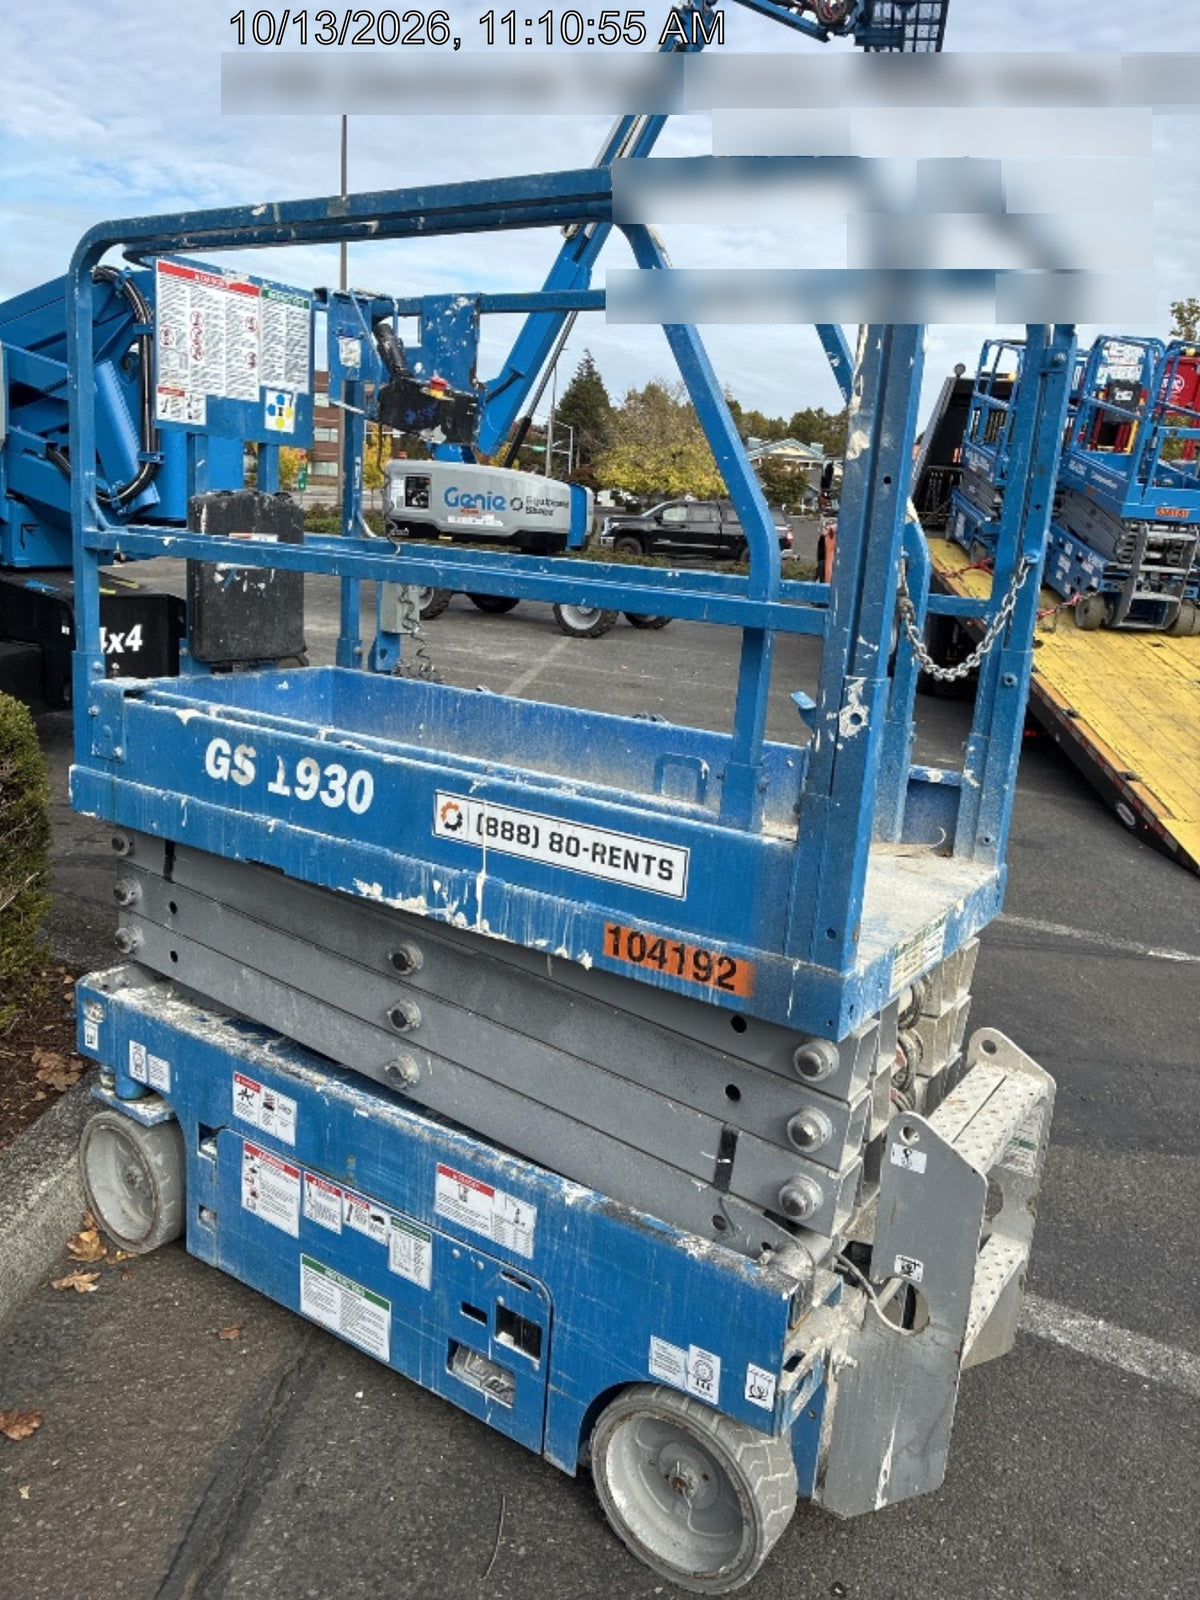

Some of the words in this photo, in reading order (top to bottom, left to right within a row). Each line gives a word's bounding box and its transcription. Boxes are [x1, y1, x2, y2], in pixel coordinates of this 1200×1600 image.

[444, 486, 507, 511] Genie
[205, 738, 257, 786] GS
[267, 755, 374, 815] 1930
[476, 812, 540, 848] (888)
[549, 831, 675, 881] 80-RENTS
[608, 925, 737, 991] 104192
